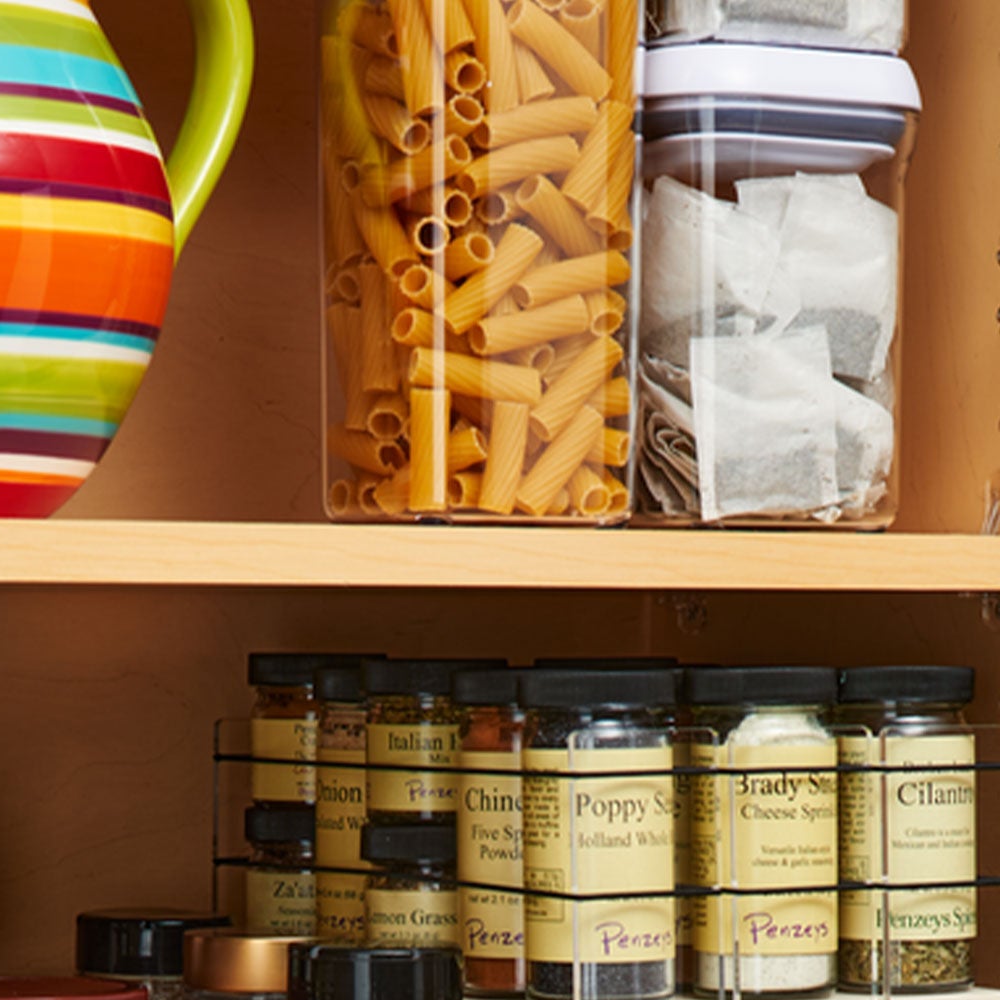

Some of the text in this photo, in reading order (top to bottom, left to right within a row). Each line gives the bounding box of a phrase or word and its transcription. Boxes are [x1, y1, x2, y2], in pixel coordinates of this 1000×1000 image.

[388, 732, 444, 751] Italian
[405, 779, 457, 802] Penze
[576, 792, 648, 824] Poppy
[740, 803, 799, 820] Cheese
[472, 823, 499, 841] Five
[465, 917, 524, 951] Penze
[743, 911, 829, 945] Penzeys
